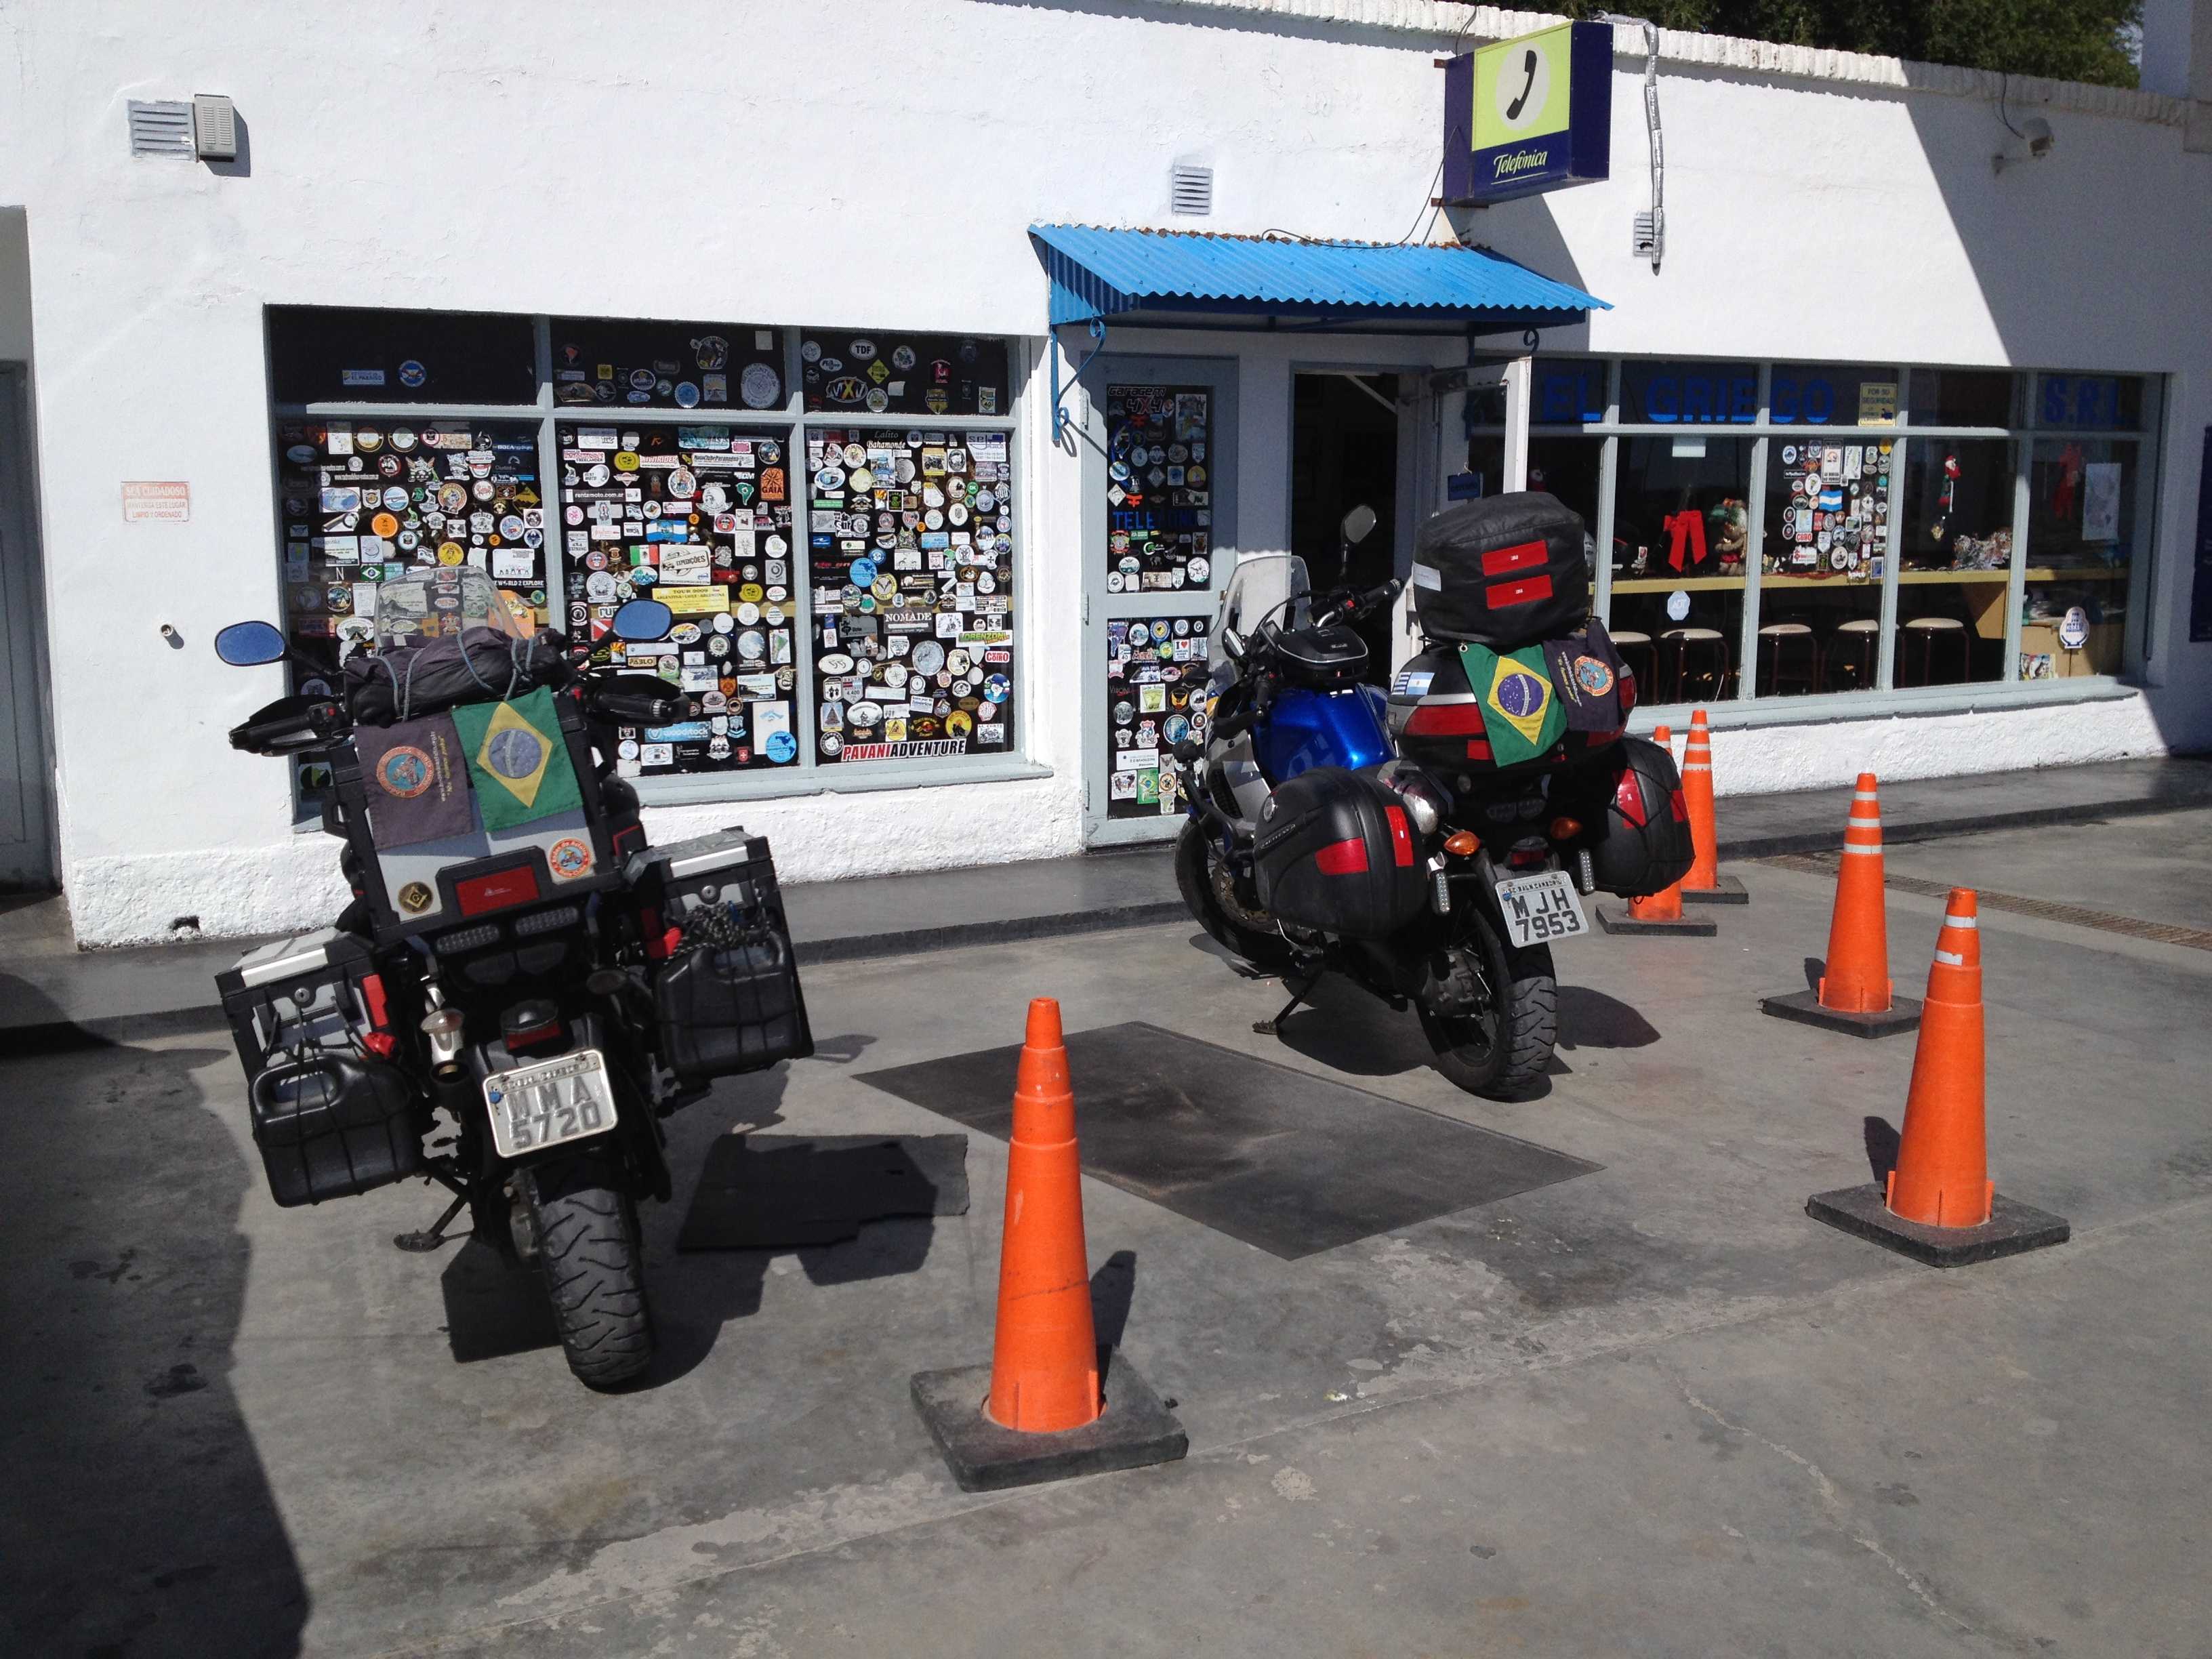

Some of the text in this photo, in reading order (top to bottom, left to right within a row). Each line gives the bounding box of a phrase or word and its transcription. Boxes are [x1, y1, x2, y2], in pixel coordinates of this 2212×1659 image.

[1493, 150, 1548, 178] Telefónica
[855, 345, 872, 354] TDF
[1544, 376, 1834, 423] EL GRIEGO
[867, 440, 906, 449] Bahamonde
[874, 430, 899, 438] Lalito
[884, 612, 933, 622] NOMADE
[1511, 888, 1570, 919] MJH
[1515, 910, 1580, 941] 7953
[510, 1101, 602, 1149] 5720
